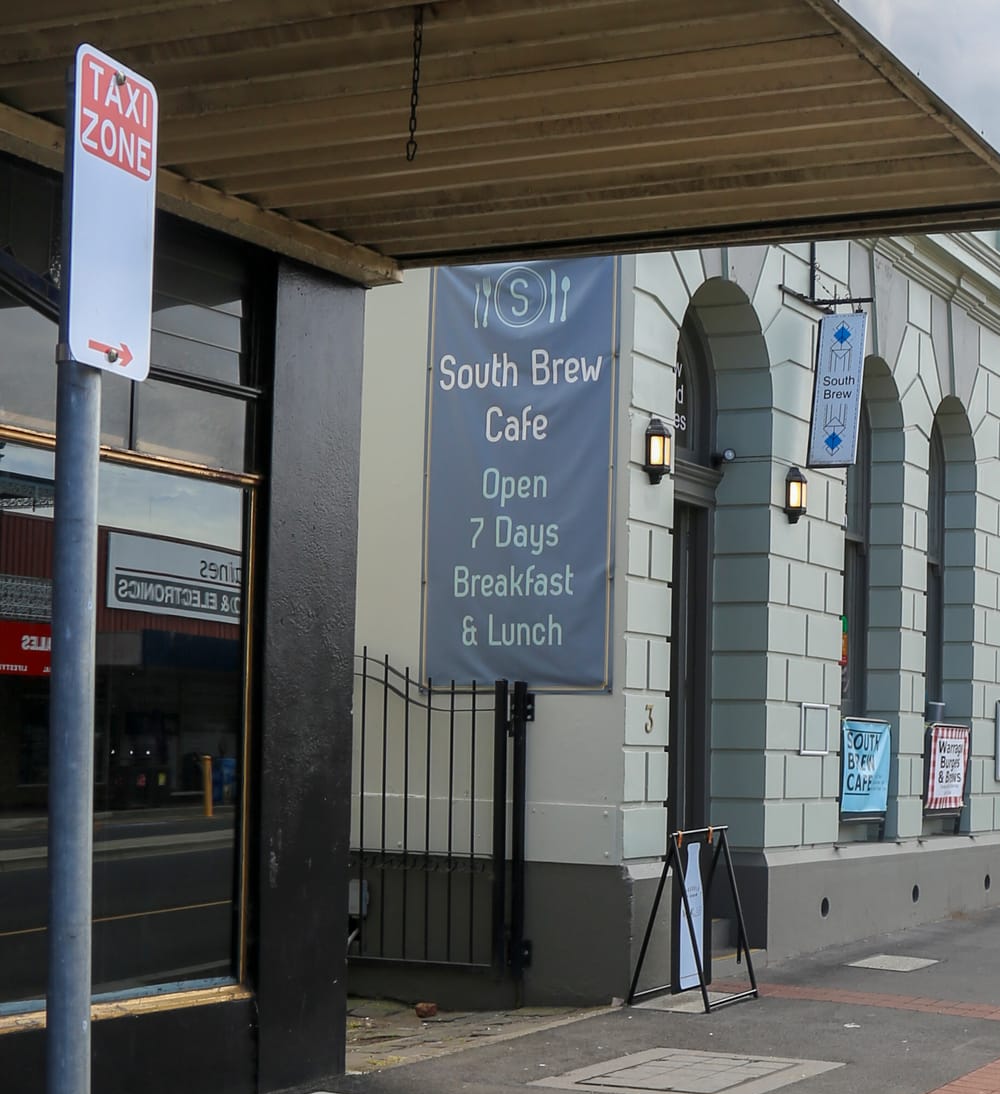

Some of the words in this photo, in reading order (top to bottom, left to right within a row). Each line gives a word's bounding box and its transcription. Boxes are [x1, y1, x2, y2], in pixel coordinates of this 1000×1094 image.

[88, 60, 148, 128] TAXI
[81, 106, 151, 177] ZONE
[510, 278, 529, 317] S
[439, 352, 519, 391] South
[531, 348, 603, 386] Brew
[822, 375, 856, 387] South
[823, 388, 853, 400] Brew
[485, 404, 549, 443] Cafe
[482, 467, 548, 508] Open
[470, 517, 485, 549] 7
[495, 515, 560, 556] Days
[453, 564, 575, 598] Breakfast
[461, 615, 479, 647] &
[488, 613, 563, 646] Lunch
[644, 703, 655, 735] 3
[847, 731, 880, 751] SOUTH
